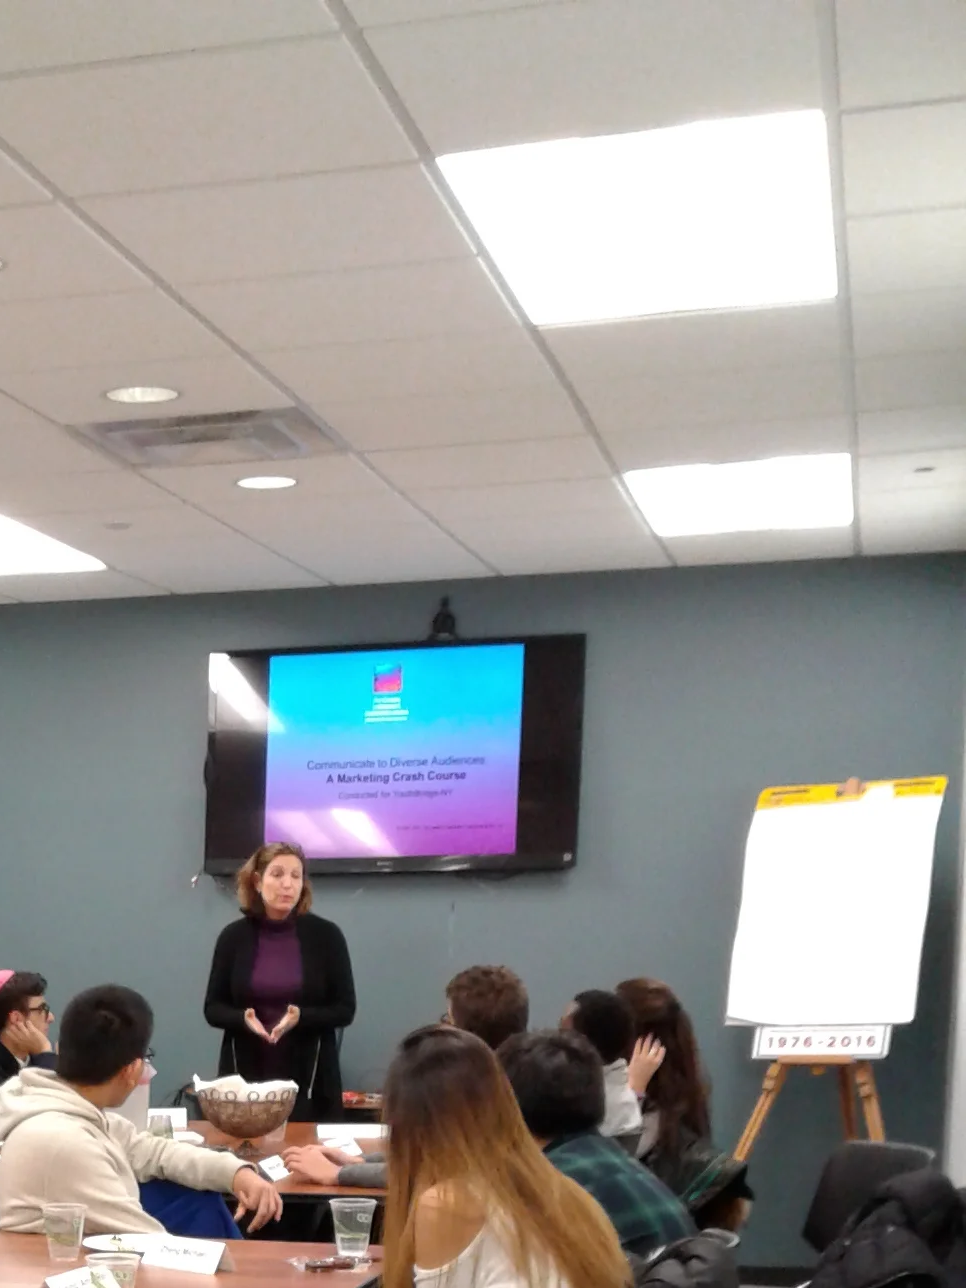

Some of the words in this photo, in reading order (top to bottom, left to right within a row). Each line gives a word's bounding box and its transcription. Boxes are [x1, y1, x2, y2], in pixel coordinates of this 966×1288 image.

[307, 758, 375, 771] Communicate
[378, 758, 388, 769] to
[390, 757, 428, 768] Diverse
[326, 774, 334, 784] A
[337, 773, 390, 785] Marketing
[392, 771, 425, 782] Crash
[428, 770, 466, 781] Course
[767, 1035, 876, 1048] 1976-2016
